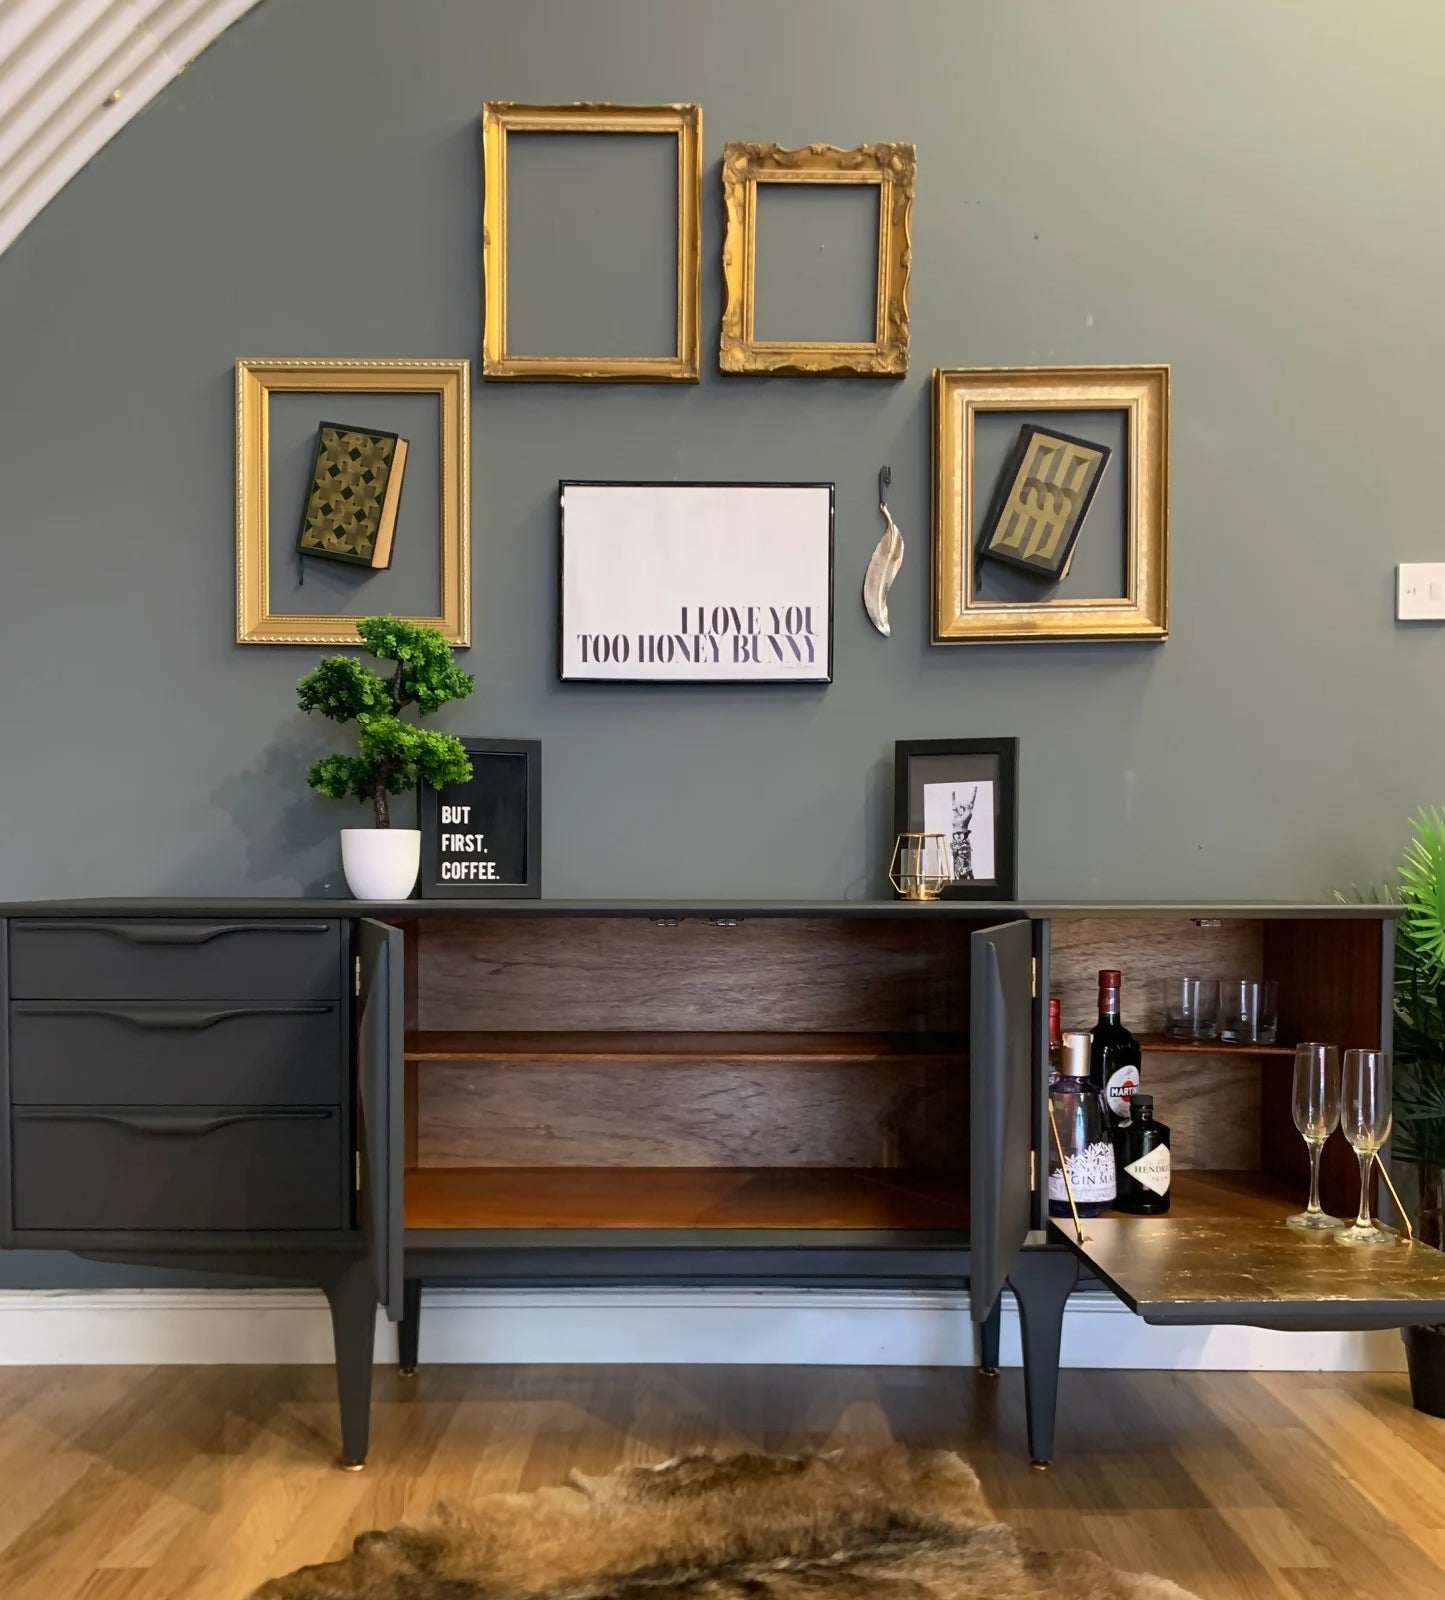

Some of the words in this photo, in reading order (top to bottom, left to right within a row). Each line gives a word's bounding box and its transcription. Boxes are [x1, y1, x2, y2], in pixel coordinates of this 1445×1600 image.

[681, 606, 688, 635] I
[698, 606, 761, 635] LOVE
[768, 606, 820, 635] YOU
[577, 634, 630, 663] TOO
[638, 634, 721, 663] HONEY
[733, 634, 817, 663] BUNNY
[441, 805, 471, 824] BUT
[441, 861, 501, 880] COFFEE.
[1071, 1175, 1096, 1185] GIN
